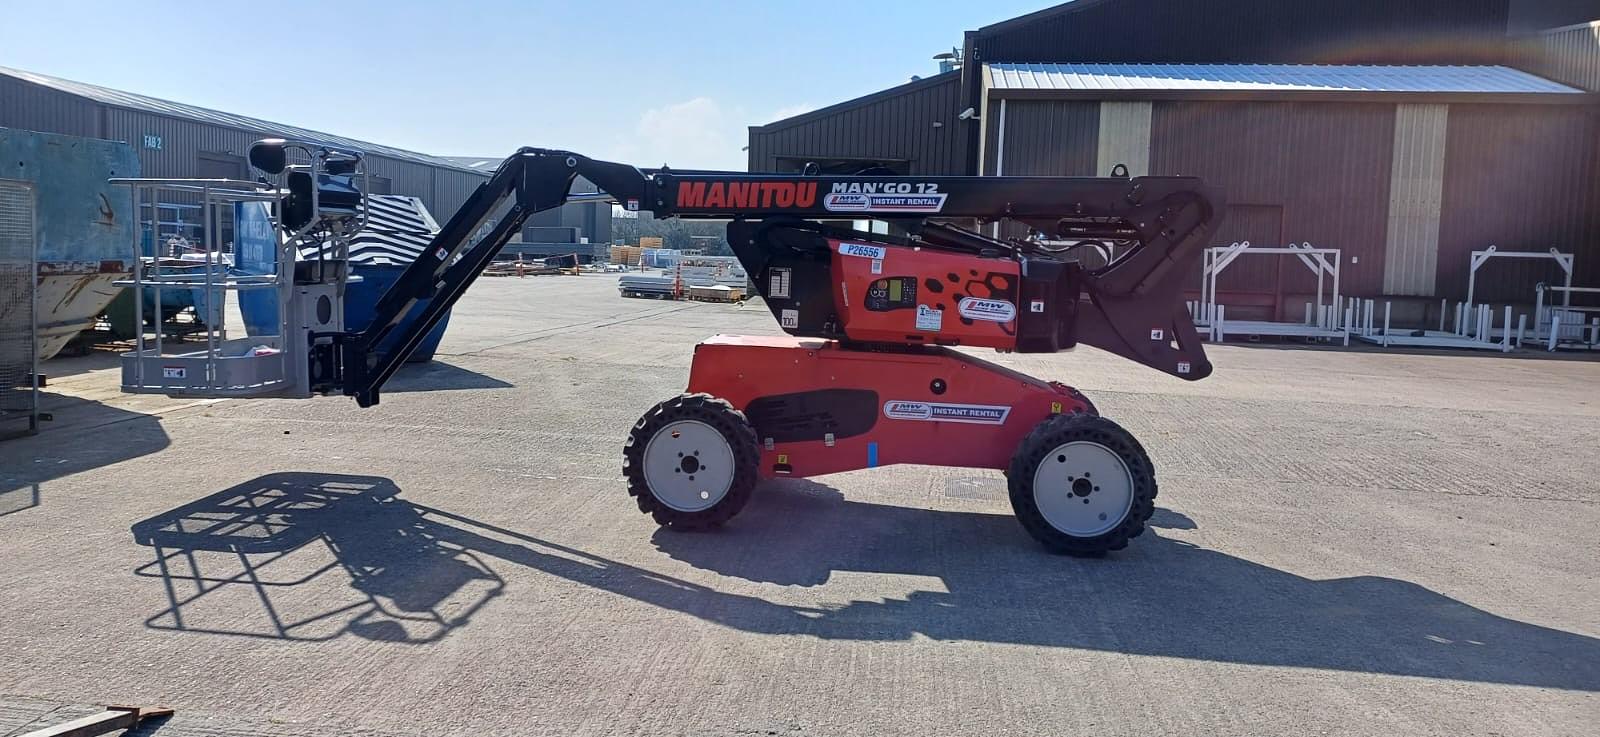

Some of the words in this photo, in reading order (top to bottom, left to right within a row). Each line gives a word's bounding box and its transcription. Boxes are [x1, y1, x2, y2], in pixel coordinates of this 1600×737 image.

[144, 135, 156, 148] FAB
[157, 136, 161, 149] 2
[831, 182, 912, 194] MAN'GO
[915, 183, 939, 194] 12
[677, 182, 817, 208] MANITOU
[847, 245, 879, 257] P26556
[977, 301, 1005, 309] MW
[933, 407, 967, 415] INSTANT
[969, 409, 1000, 417] RENTAL
